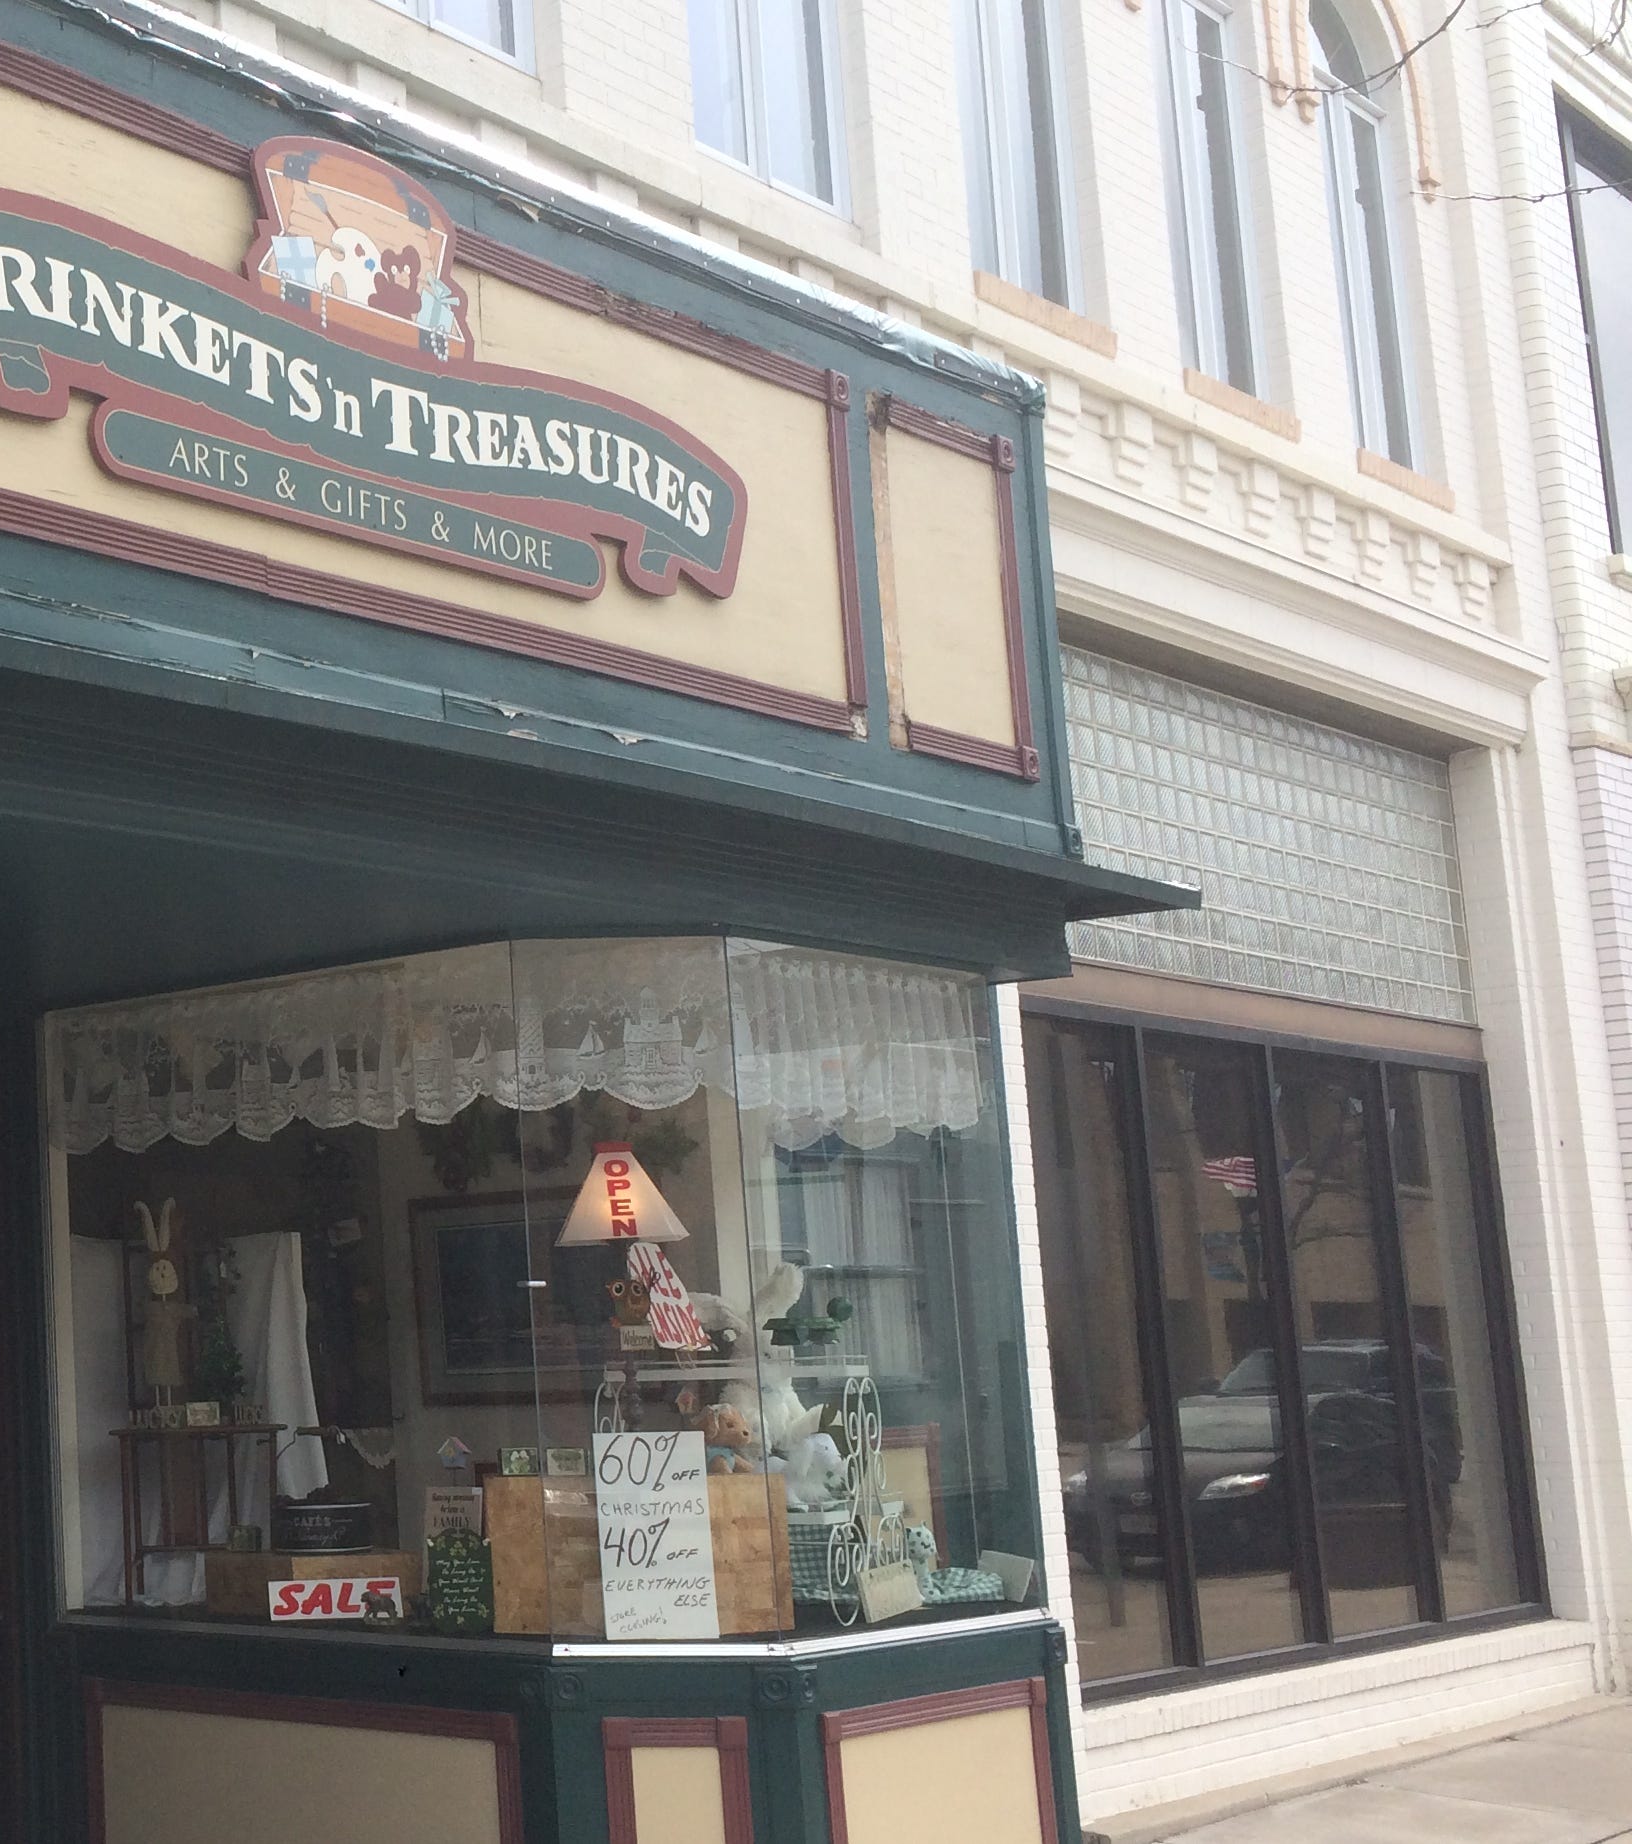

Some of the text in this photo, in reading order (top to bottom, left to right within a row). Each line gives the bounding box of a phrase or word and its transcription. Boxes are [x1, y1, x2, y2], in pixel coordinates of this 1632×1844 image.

[370, 378, 714, 537] TREASURES
[169, 439, 553, 571] ARTS & GIFTS & MORE
[604, 1160, 638, 1236] OPEN
[599, 1432, 700, 1492] 60% OFF
[601, 1498, 705, 1516] CHRISTMAS
[604, 1518, 699, 1568] 40% OFF
[605, 1577, 710, 1592] EVERYTHING
[674, 1593, 710, 1607] ELSE
